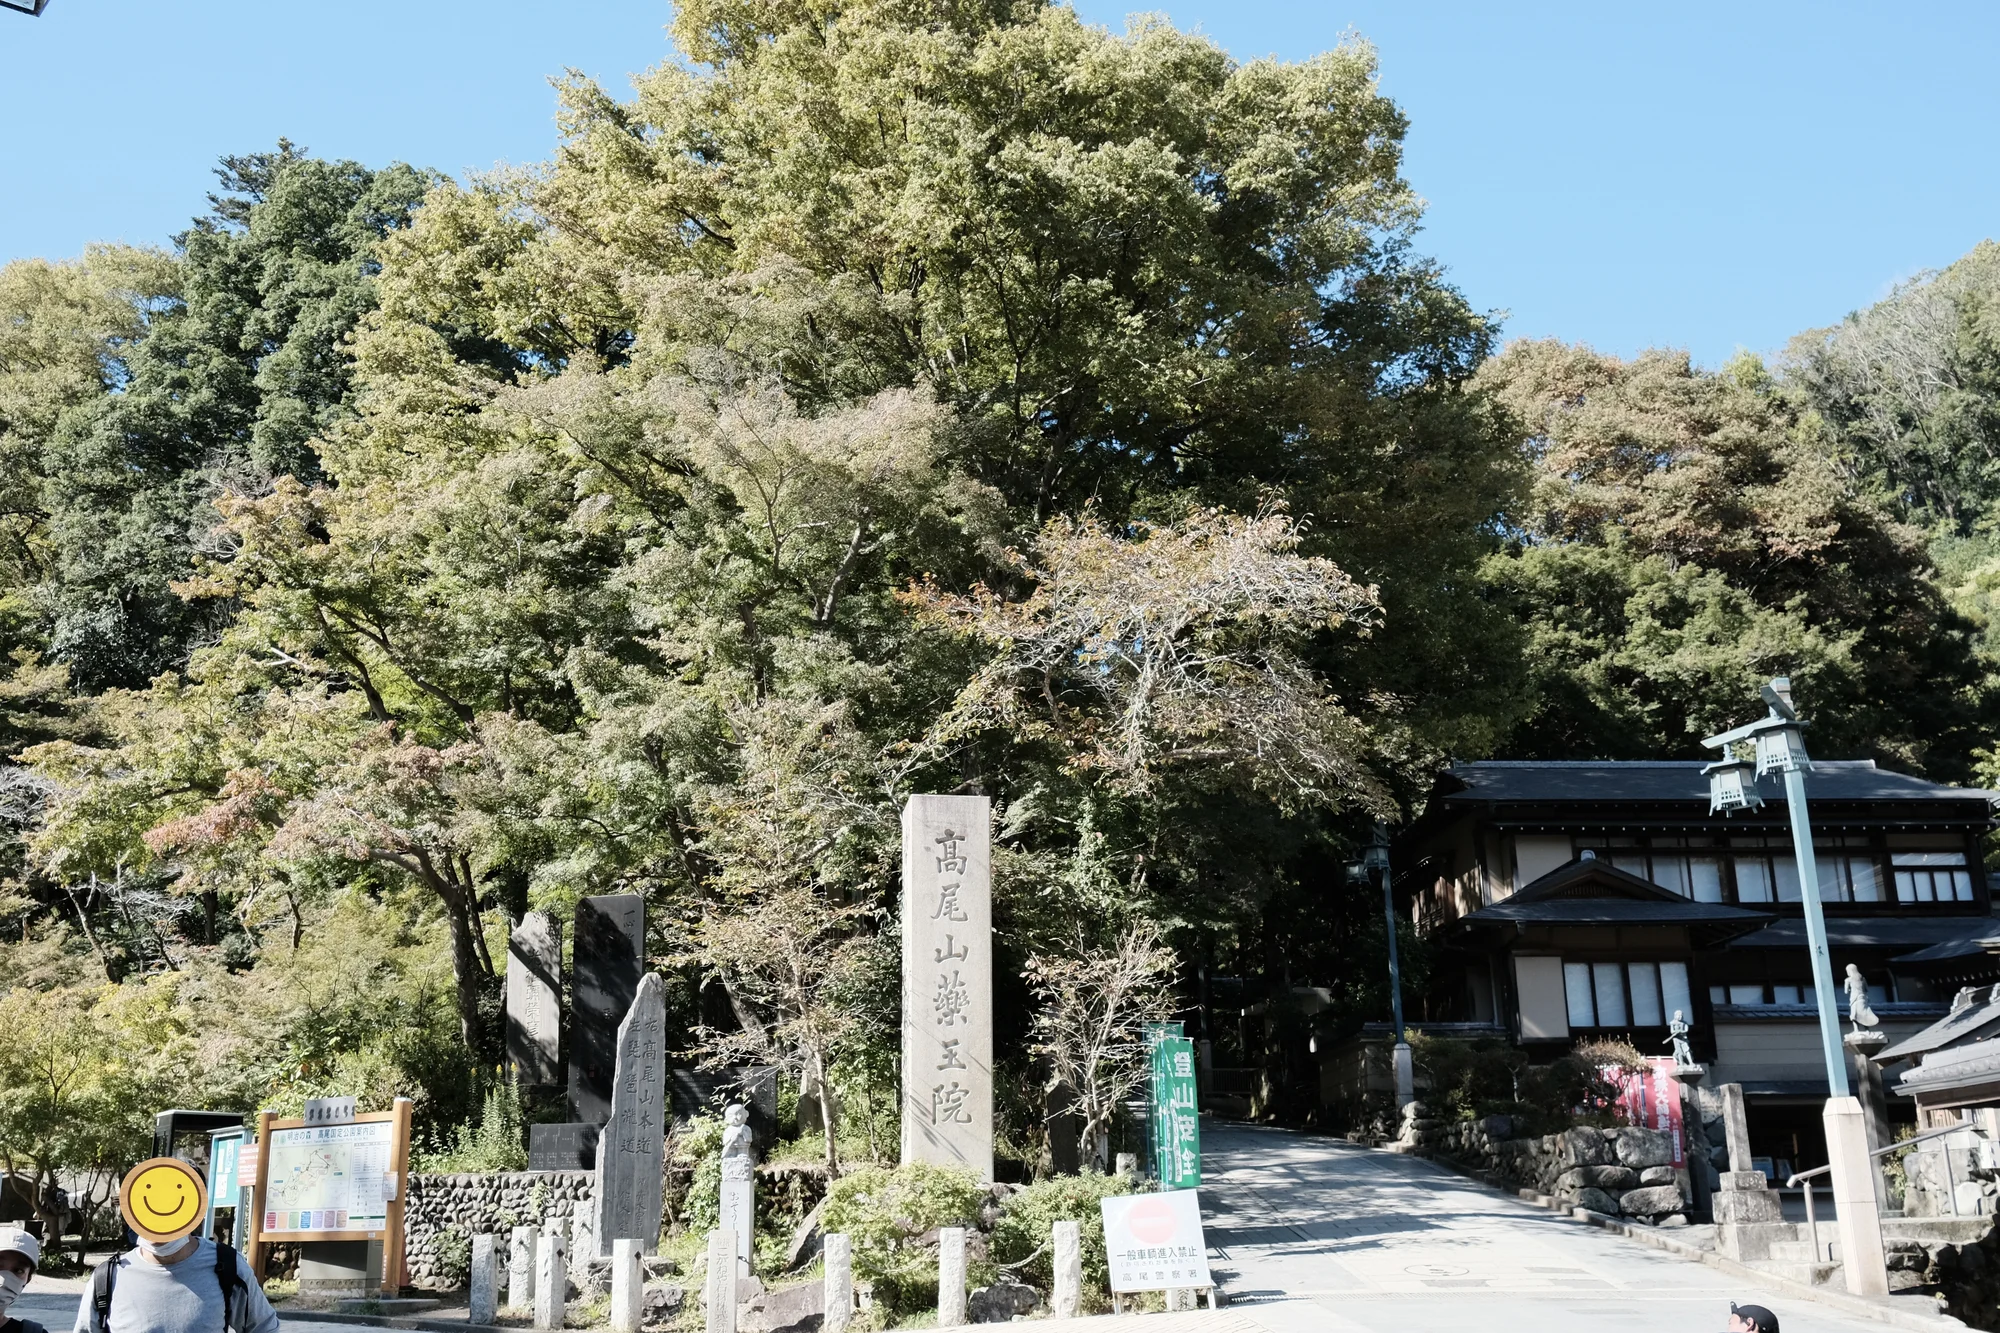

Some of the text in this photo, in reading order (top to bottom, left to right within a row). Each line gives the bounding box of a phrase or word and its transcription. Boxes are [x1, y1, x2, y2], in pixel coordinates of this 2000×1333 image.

[1174, 1051, 1197, 1176] 登山安全
[287, 1131, 311, 1141] 明治の森
[1122, 1269, 1197, 1282] 高尾警察署
